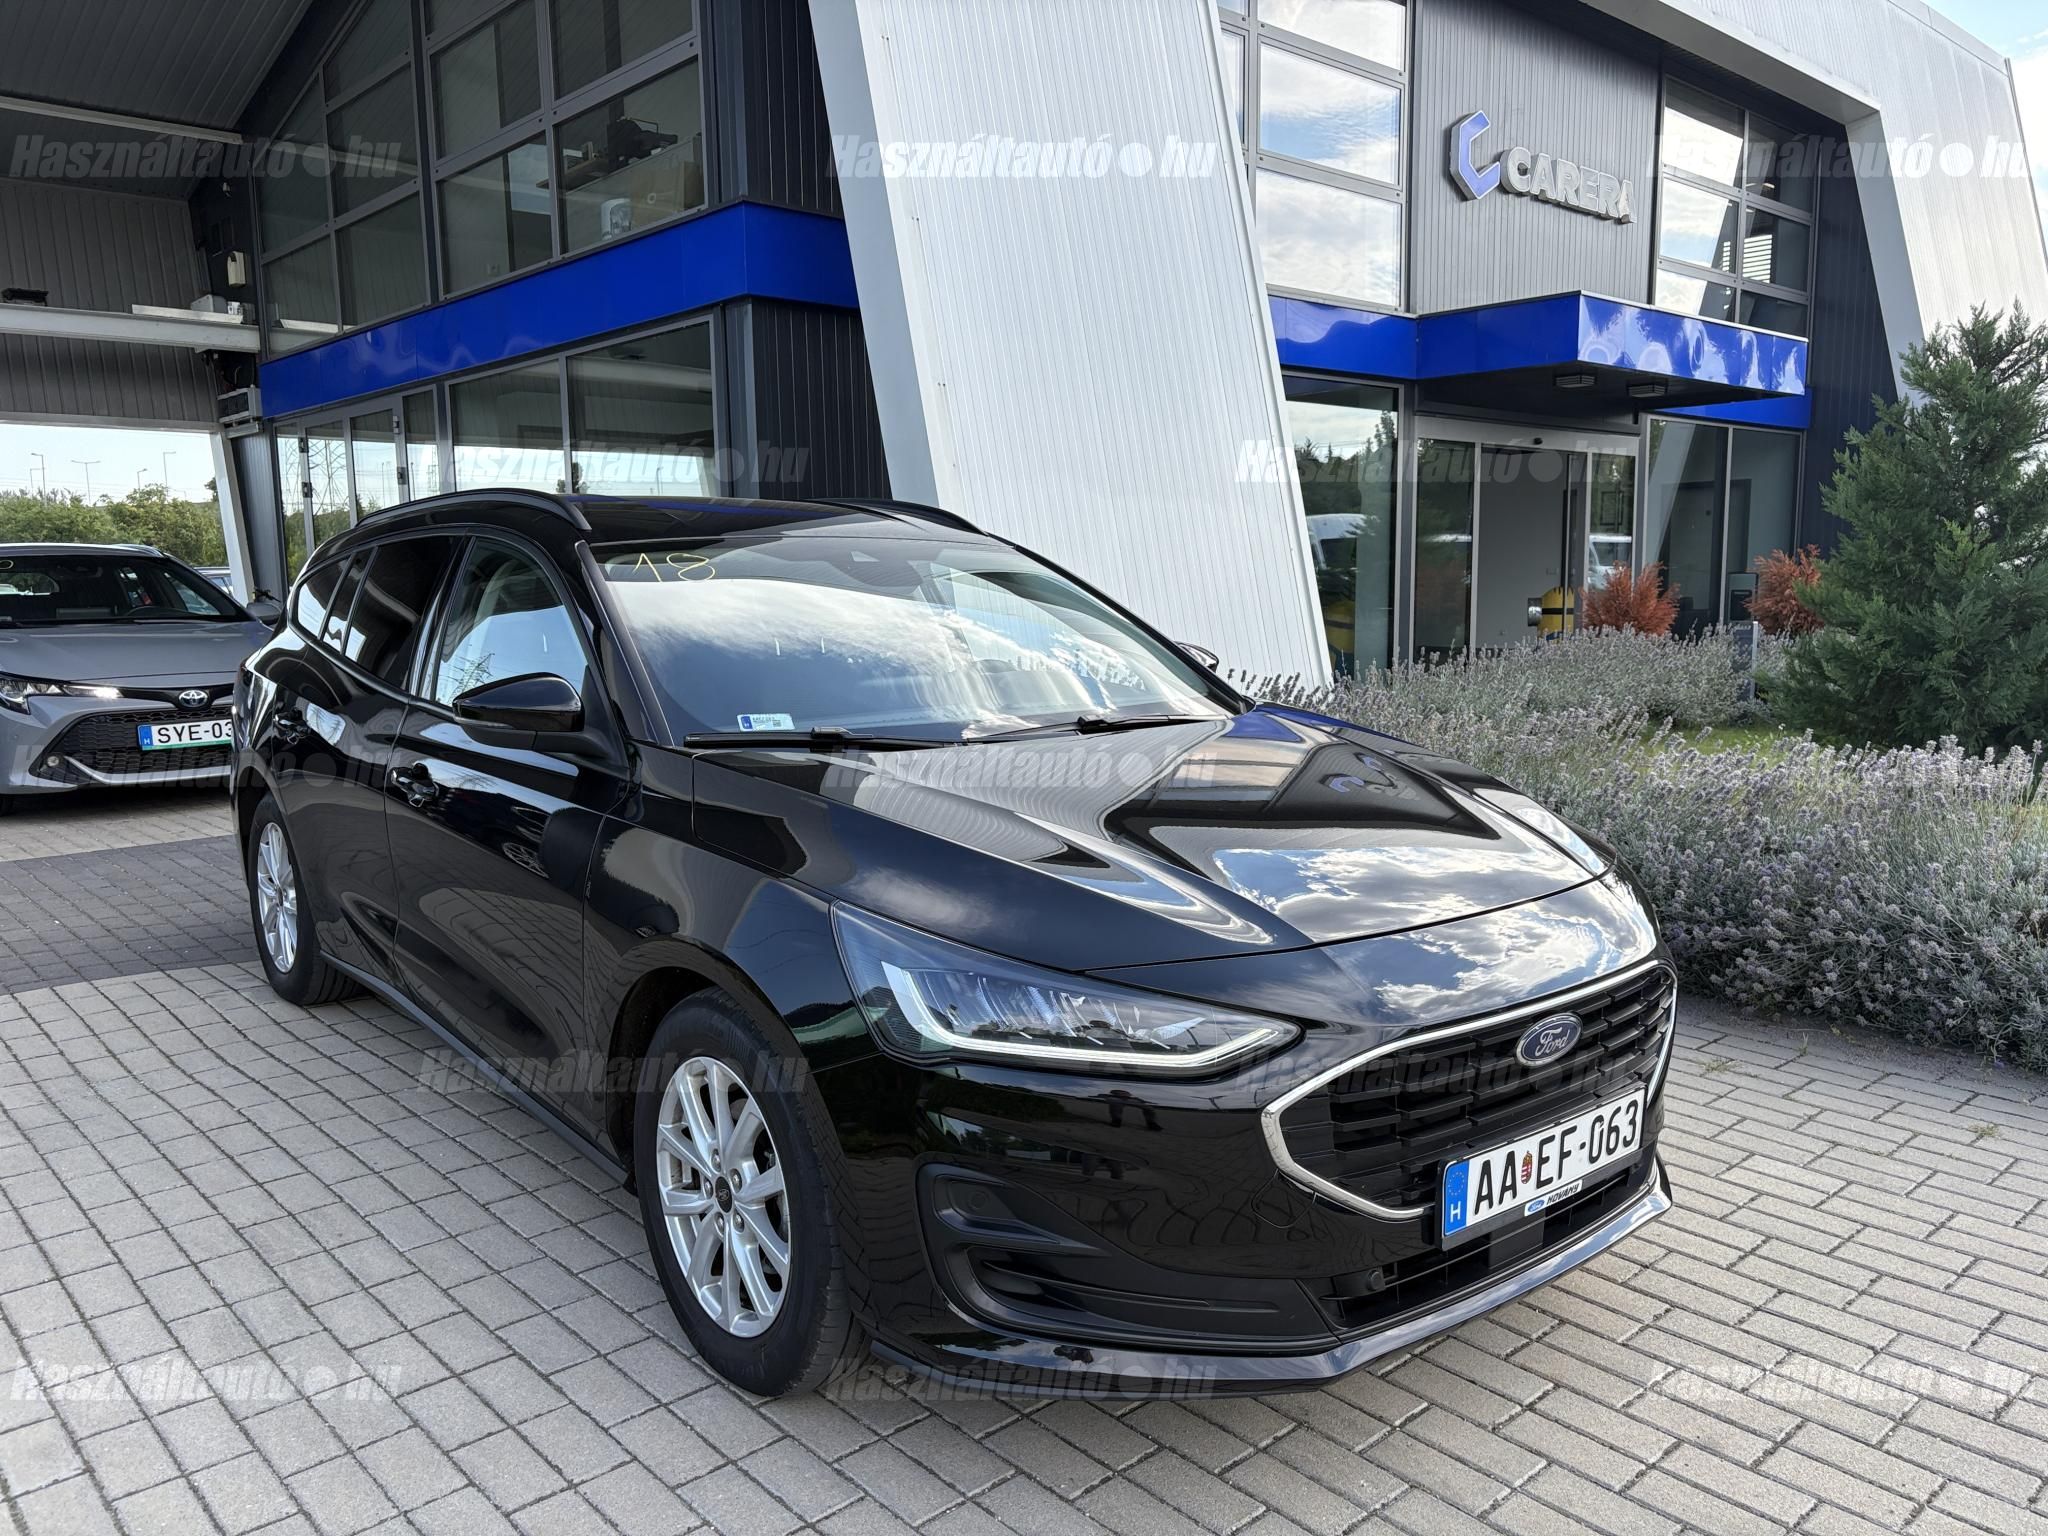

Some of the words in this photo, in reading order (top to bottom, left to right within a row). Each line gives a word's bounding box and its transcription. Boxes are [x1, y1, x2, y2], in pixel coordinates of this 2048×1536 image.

[1501, 147, 1638, 224] CARERA
[632, 553, 715, 582] 18
[1534, 1026, 1571, 1057] Ford
[1450, 1201, 1461, 1223] H
